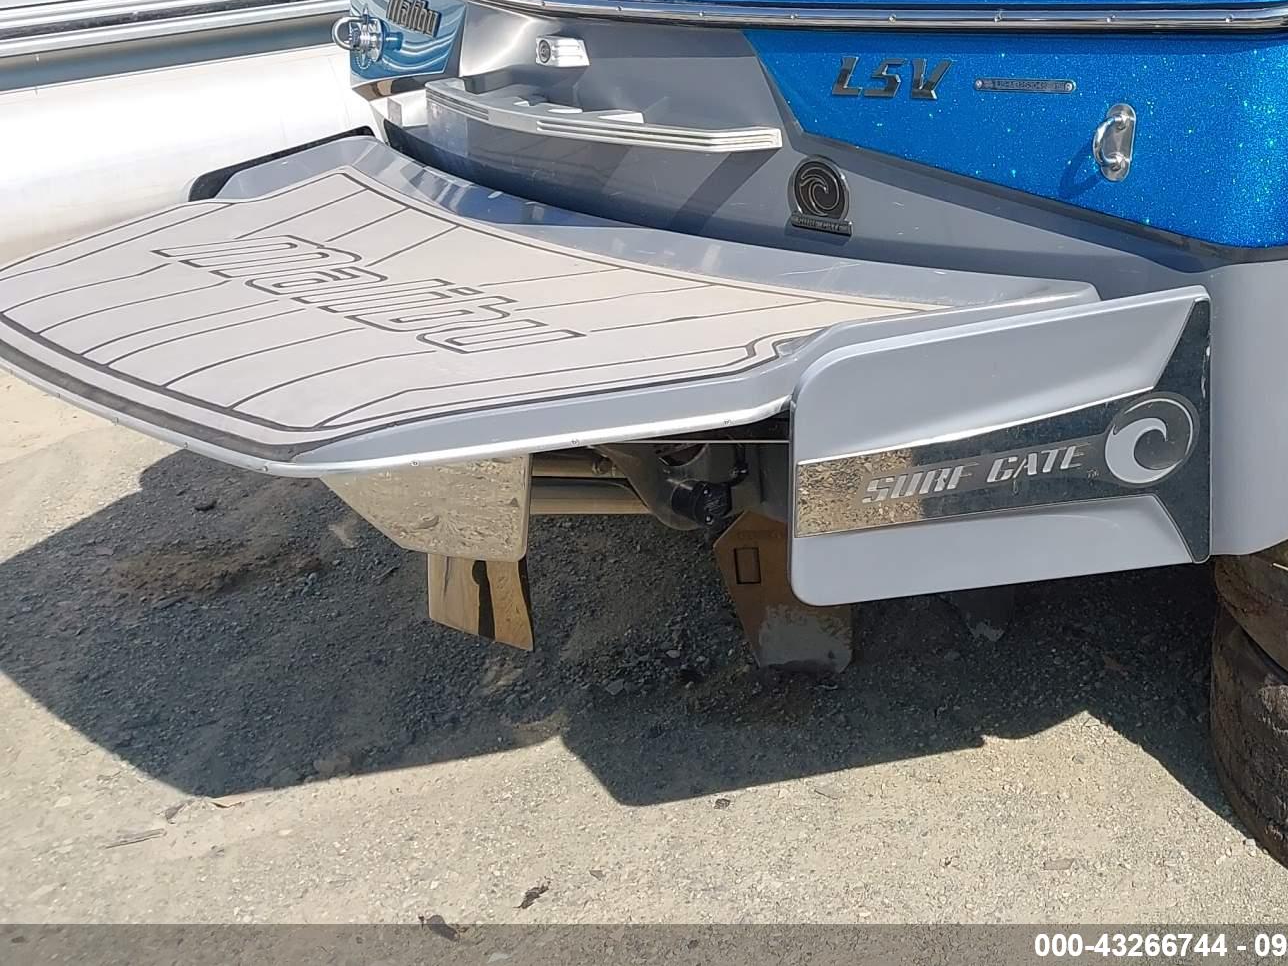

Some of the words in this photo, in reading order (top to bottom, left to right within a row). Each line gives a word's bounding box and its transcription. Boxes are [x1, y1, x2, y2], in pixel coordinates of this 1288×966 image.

[832, 56, 953, 99] LSV
[862, 462, 978, 503] SURF
[986, 442, 1090, 483] GATE
